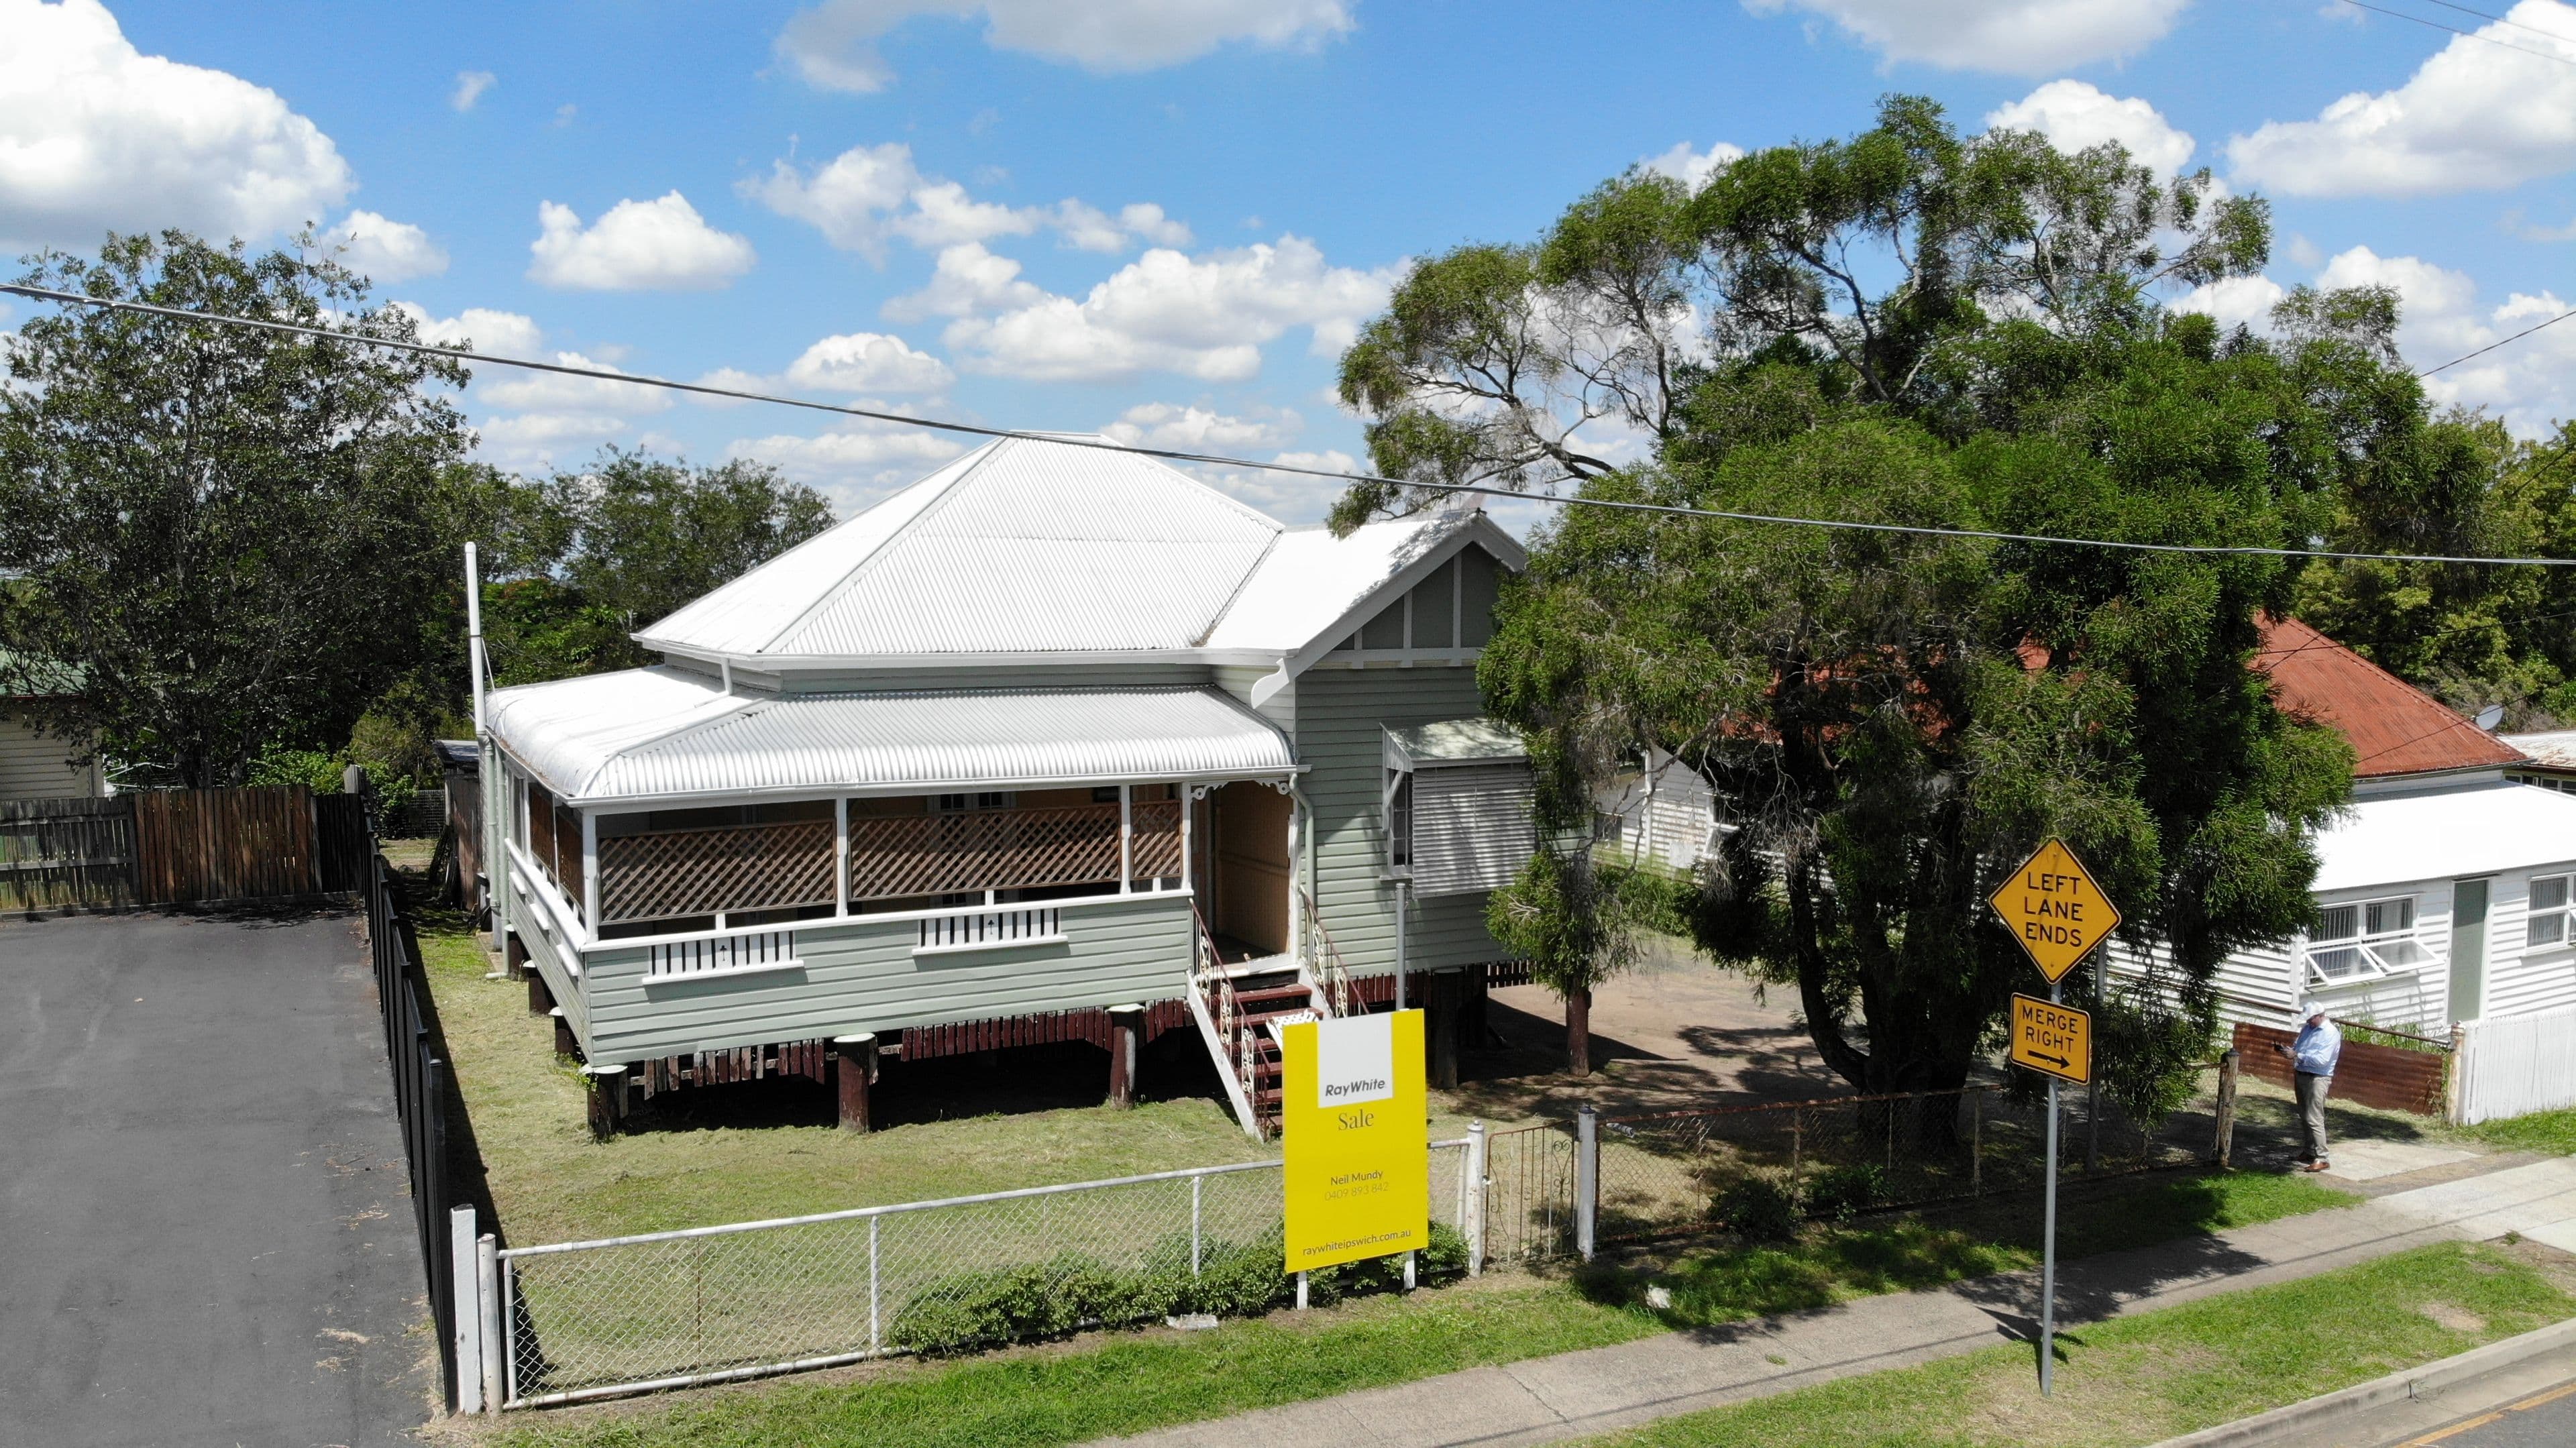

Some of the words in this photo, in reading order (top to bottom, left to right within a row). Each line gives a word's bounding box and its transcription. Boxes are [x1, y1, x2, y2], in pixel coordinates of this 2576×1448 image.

[2027, 871, 2081, 895] LEFT
[2024, 896, 2083, 922] LANE
[2025, 922, 2082, 948] ENDS
[2022, 1005, 2079, 1034] MERGE
[2025, 1025, 2074, 1053] RIGHT
[1338, 1109, 1375, 1131] Sale
[1330, 1174, 1349, 1186] Neil
[1352, 1170, 1383, 1182] Mundy
[1324, 1188, 1348, 1201] 0409
[1351, 1185, 1368, 1196] 893
[1371, 1182, 1389, 1193] 842
[1302, 1229, 1411, 1256] raywhiteipswich.com.au
